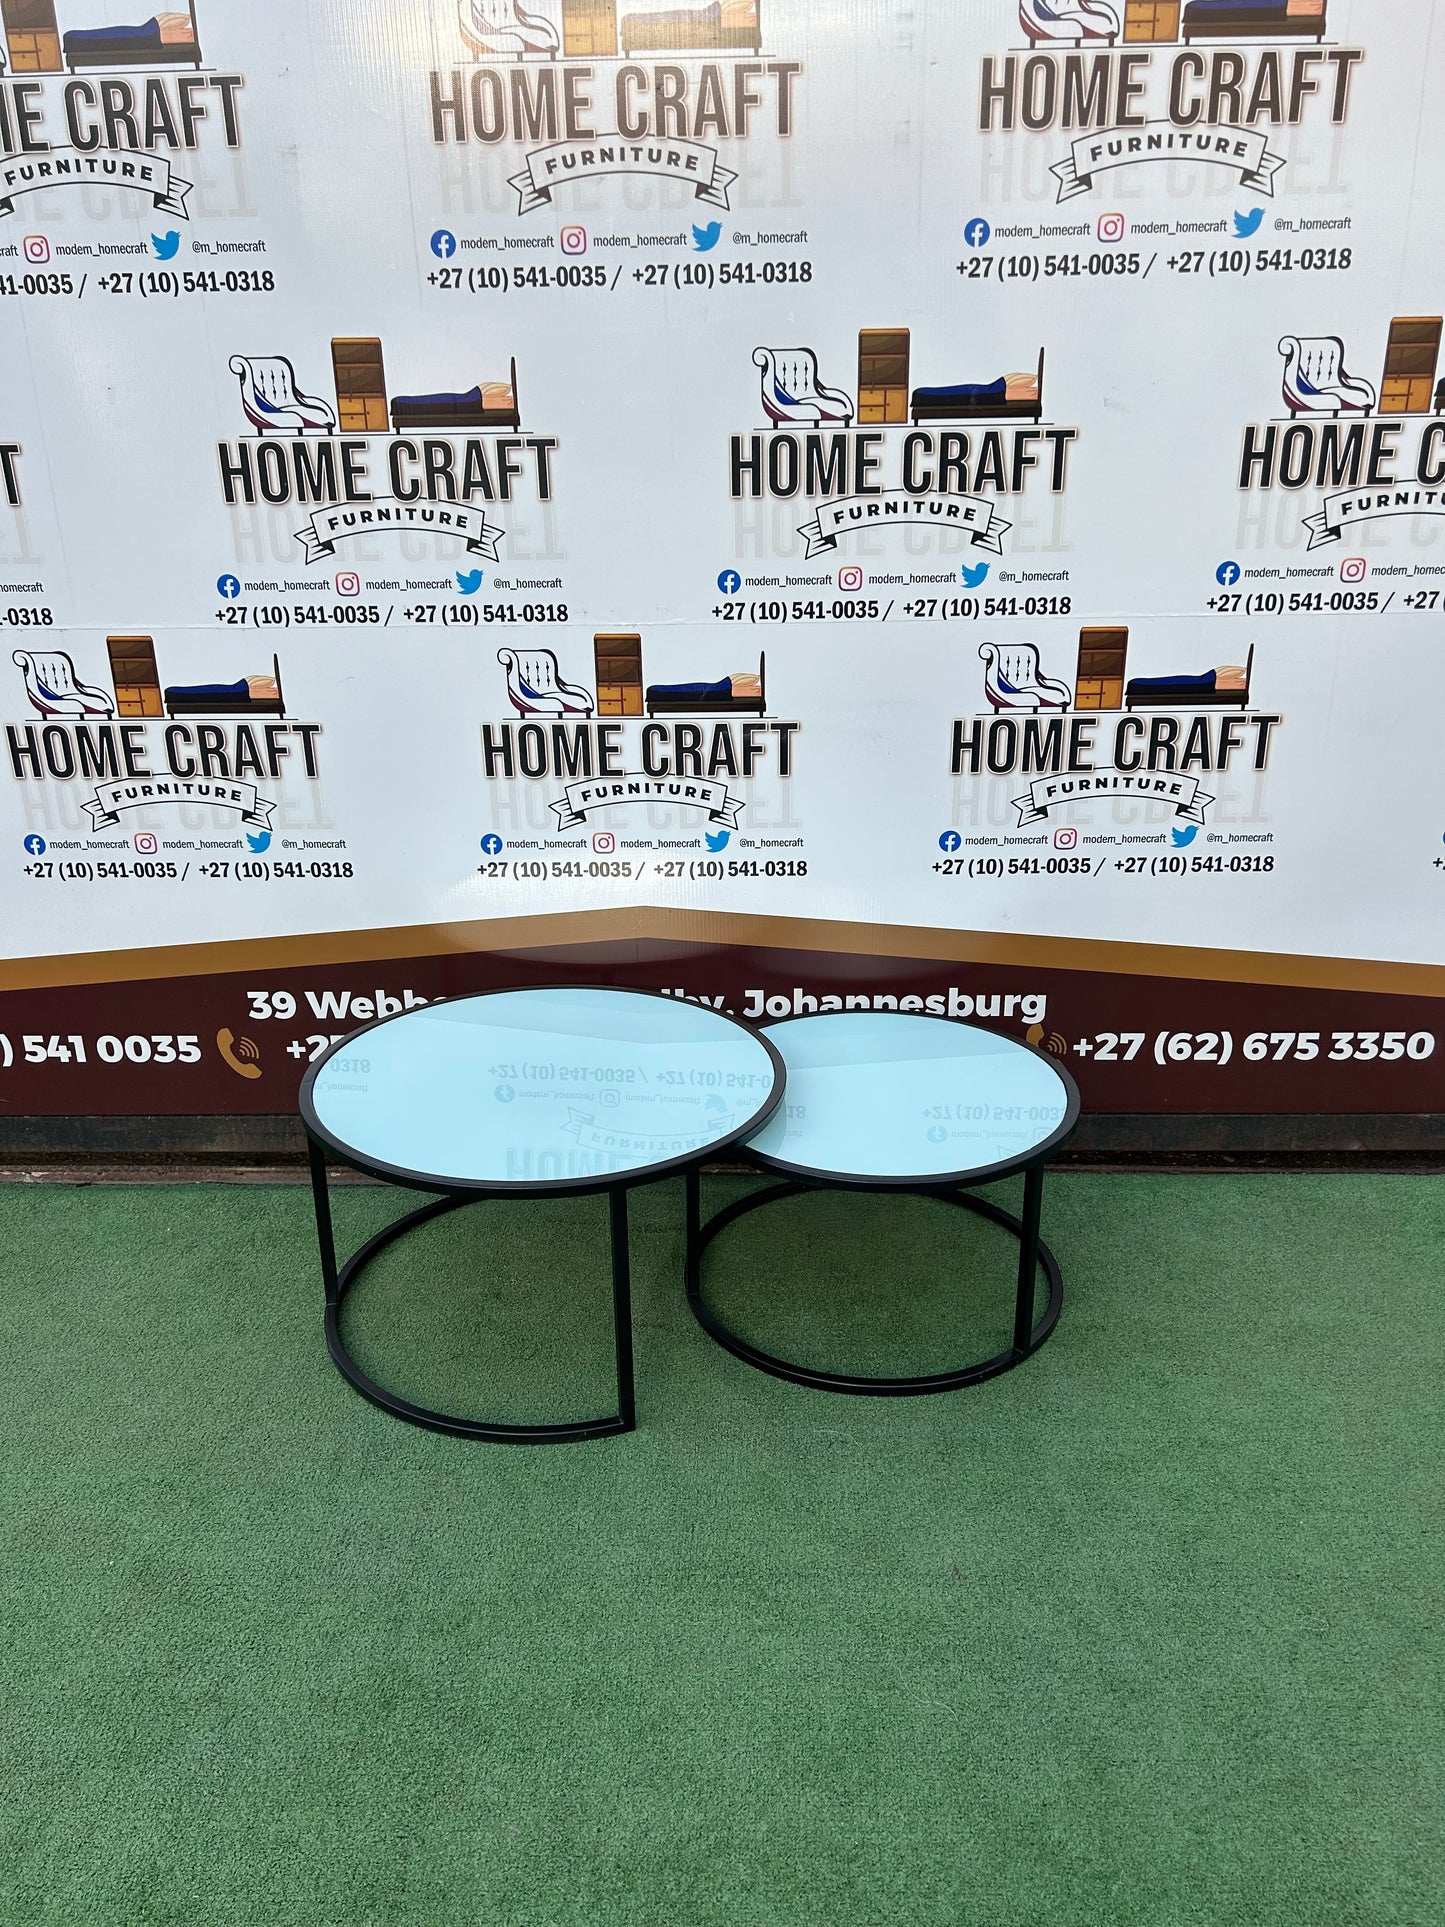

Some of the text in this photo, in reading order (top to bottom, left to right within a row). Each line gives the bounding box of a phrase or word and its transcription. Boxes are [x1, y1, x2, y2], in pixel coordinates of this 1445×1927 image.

[430, 62, 800, 142] HOME CRAFT
[979, 49, 1361, 129] HOME CRAFT
[64, 75, 242, 152] CRAFT
[545, 146, 699, 175] FURNITURE
[1090, 133, 1248, 162] FURNITURE
[4, 158, 153, 188] FURNITURE
[732, 231, 808, 246] @m_homecraft
[1274, 217, 1351, 234] @m_homecraft
[192, 239, 266, 256] @m_homecraft
[427, 261, 812, 292] +27 (10) 541-0035 / +27 (10) 541-0318
[956, 248, 1352, 282] +27 (10) 541-0035 / +27 (10) 541-0318
[78, 273, 87, 298] /
[98, 272, 133, 294] +27
[139, 271, 179, 298] (10)
[183, 270, 275, 293] 541-0318
[731, 430, 1076, 497] HOME CRAFT
[1239, 423, 1402, 488] HOME
[218, 439, 557, 502] HOME CRAFT
[328, 508, 468, 531] FURNITURE
[834, 501, 976, 524] FURNITURE
[493, 577, 562, 590] @m_homecraft
[998, 570, 1070, 583] @m_homecraft
[215, 604, 568, 627] +27 (10) 541-0035 / +27 (10) 541-0318
[711, 596, 1072, 623] +27 (10) 541-0035 / +27 (10) 541-0318
[1207, 595, 1241, 612] +27
[1246, 594, 1284, 615] (10)
[1289, 593, 1378, 611] 541-0035
[1380, 592, 1395, 613] /
[1404, 592, 1439, 609] +27
[6, 722, 320, 778] HOME CRAFT
[482, 722, 798, 778] HOME CRAFT
[950, 715, 1280, 774] HOME CRAFT
[112, 783, 242, 802] FURNITURE
[581, 783, 712, 802] FURNITURE
[1046, 777, 1182, 798] FURNITURE
[282, 839, 347, 850] @m_homecraft
[739, 838, 803, 849] @m_homecraft
[1206, 831, 1273, 844] @m_homecraft
[23, 862, 354, 881] +27 (10) 541-0035 / +27 (10) 541-0318
[477, 860, 807, 880] +27 (10) 541-0035 / +27 (10) 541-0318
[932, 854, 1274, 878] +27 (10) 541-0035 / +27 (10) 541-0318
[247, 991, 296, 1019] 39
[743, 988, 1047, 1024] Johannesburg
[23, 1034, 87, 1063] 541
[96, 1034, 202, 1063] 0035
[1072, 1032, 1435, 1065] +27 (62) 675 3350
